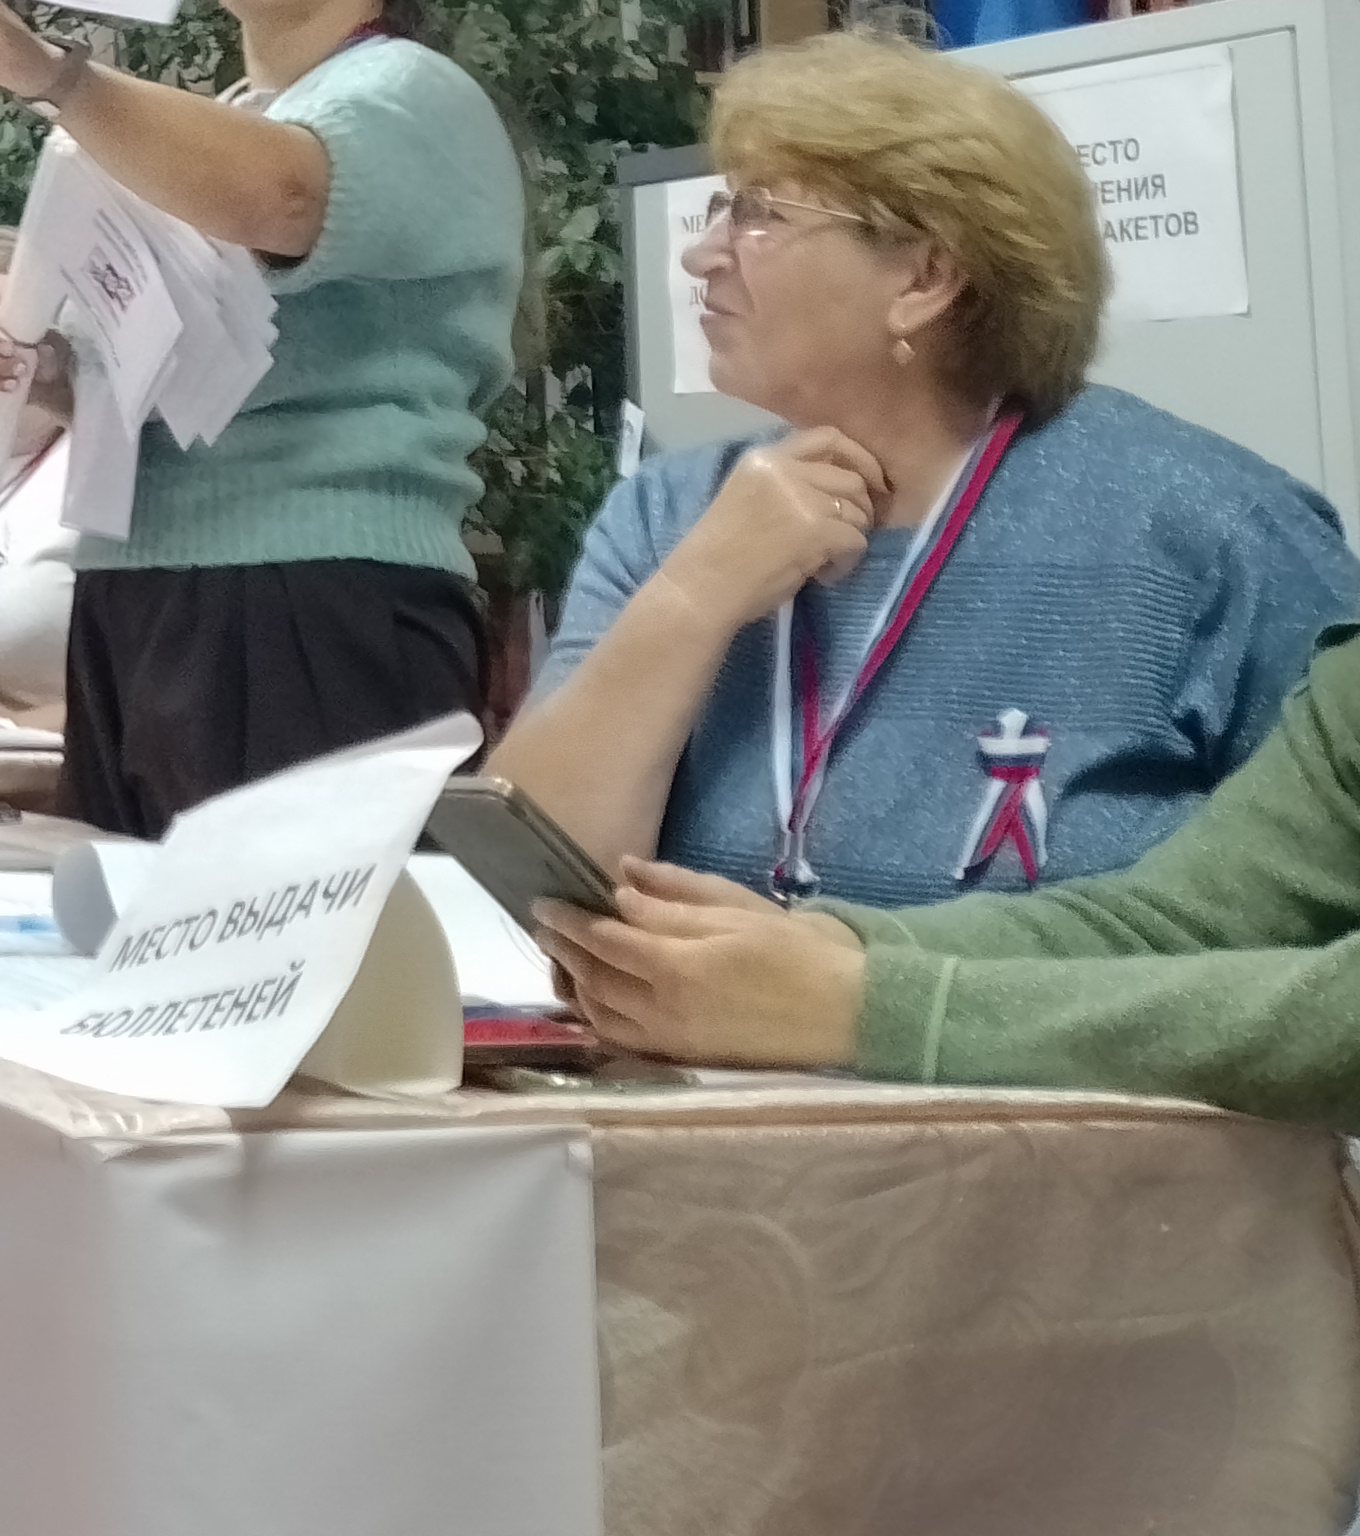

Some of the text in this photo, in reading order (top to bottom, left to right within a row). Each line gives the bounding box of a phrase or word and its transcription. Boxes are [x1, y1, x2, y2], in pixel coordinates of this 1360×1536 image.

[1076, 138, 1141, 167] ЕСТО
[1097, 174, 1168, 204] ЕНИЯ
[1103, 211, 1200, 243] АКЕТОВ
[108, 863, 380, 973] МЕСТО ВЫДАЧИ
[60, 958, 307, 1039] БЮЛЛЕТЕНЕЙ
